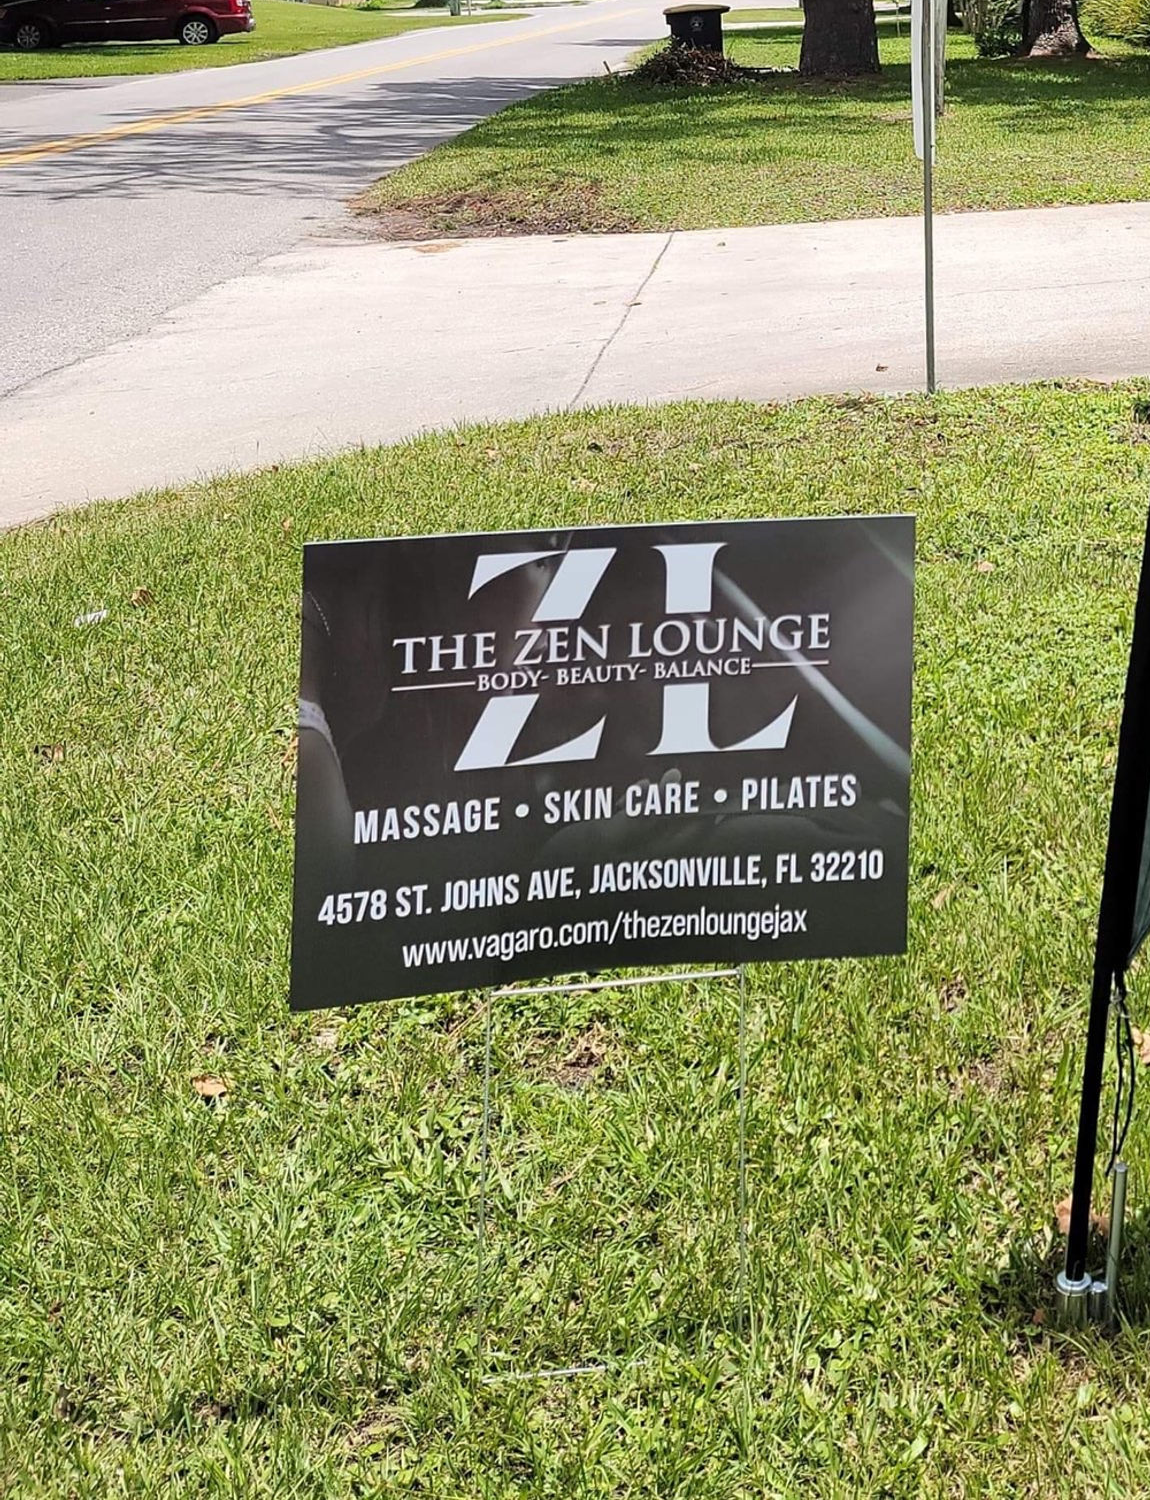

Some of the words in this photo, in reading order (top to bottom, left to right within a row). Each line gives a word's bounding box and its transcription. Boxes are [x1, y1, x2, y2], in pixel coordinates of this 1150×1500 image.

[391, 631, 497, 674] THE
[513, 624, 610, 666] ZEN
[628, 613, 831, 659] LOUNGE
[653, 657, 752, 680] BALANCE
[353, 797, 501, 845] MASSAGE
[543, 786, 612, 824] SKIN
[625, 781, 701, 817] CARE
[740, 774, 857, 811] PILATES
[317, 889, 387, 927] 4578
[395, 883, 433, 919] ST.
[441, 873, 520, 913] JOHNS
[526, 866, 582, 902] AVE,
[588, 855, 768, 895] JACKSONVILLE,
[776, 853, 804, 884] FL
[810, 849, 885, 883] 32210
[401, 904, 808, 969] www.vagaro.com/thezenloungejax
